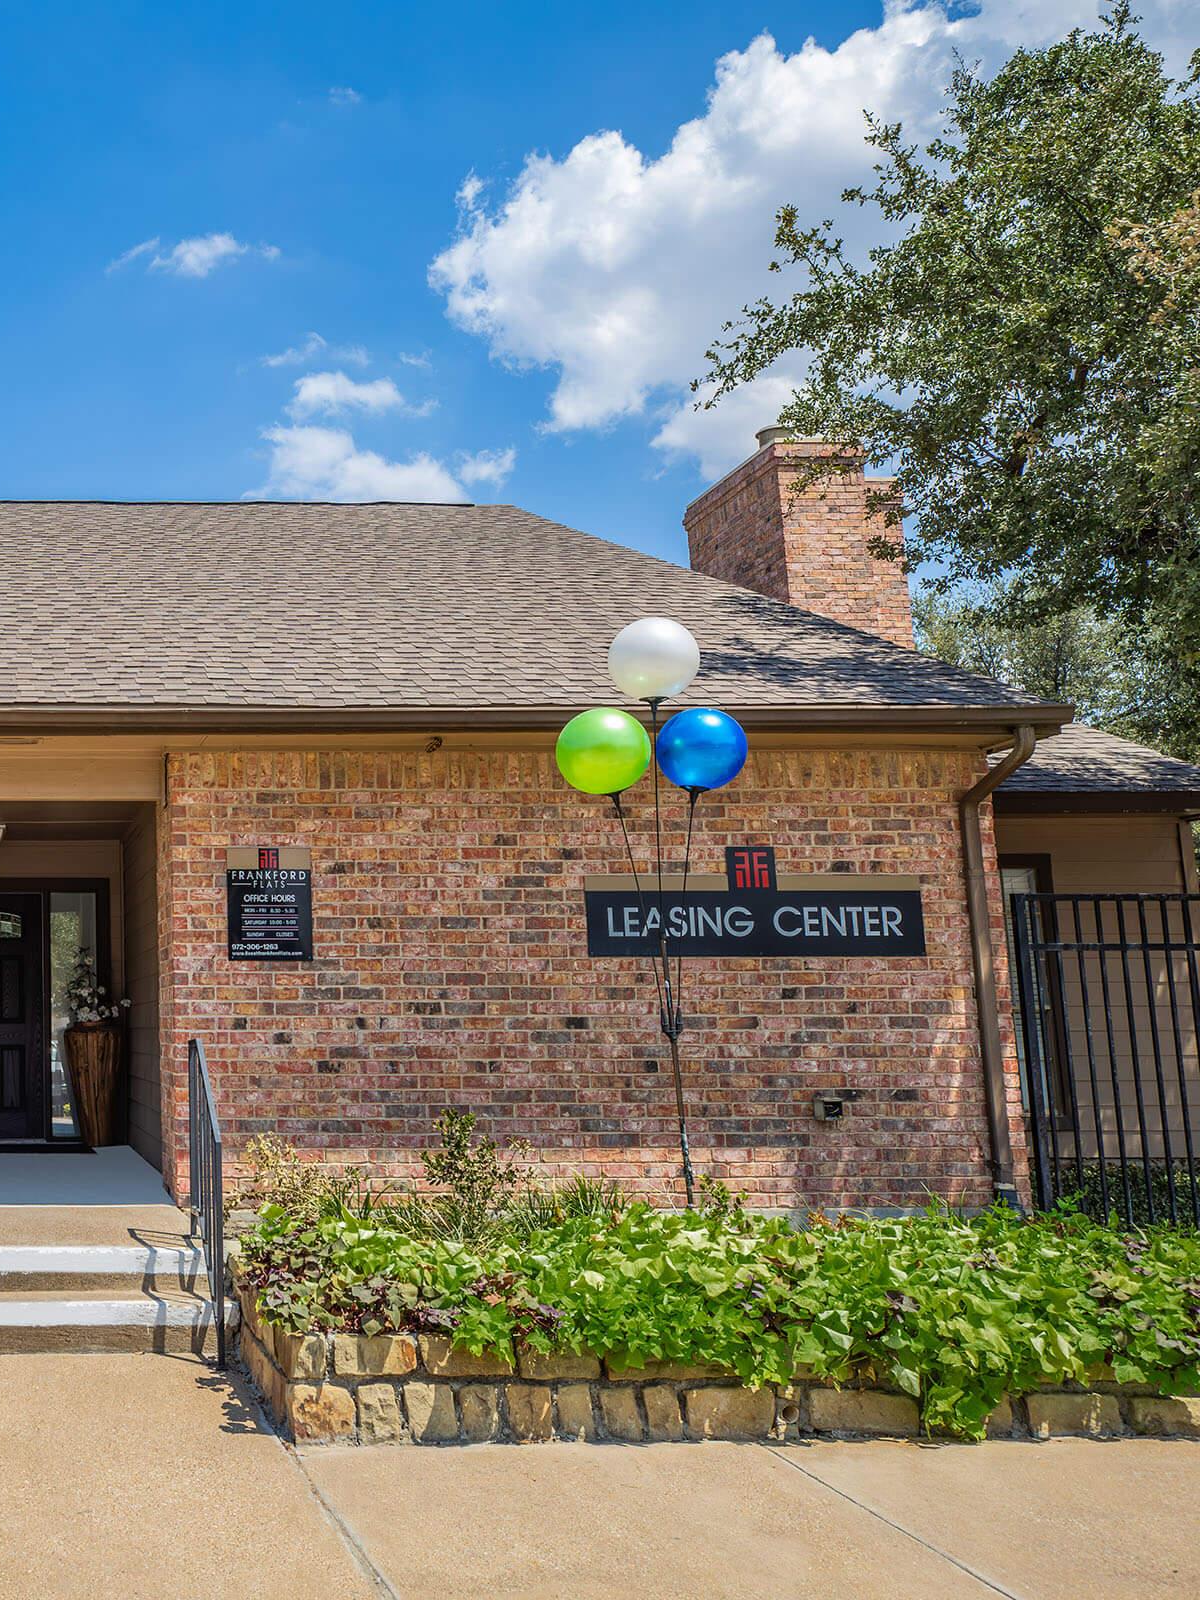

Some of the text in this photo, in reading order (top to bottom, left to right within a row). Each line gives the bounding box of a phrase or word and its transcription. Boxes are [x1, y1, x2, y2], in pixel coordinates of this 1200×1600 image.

[231, 871, 306, 880] FRANKFORD
[253, 880, 286, 888] FLATS
[607, 905, 904, 938] LEASING CENTER
